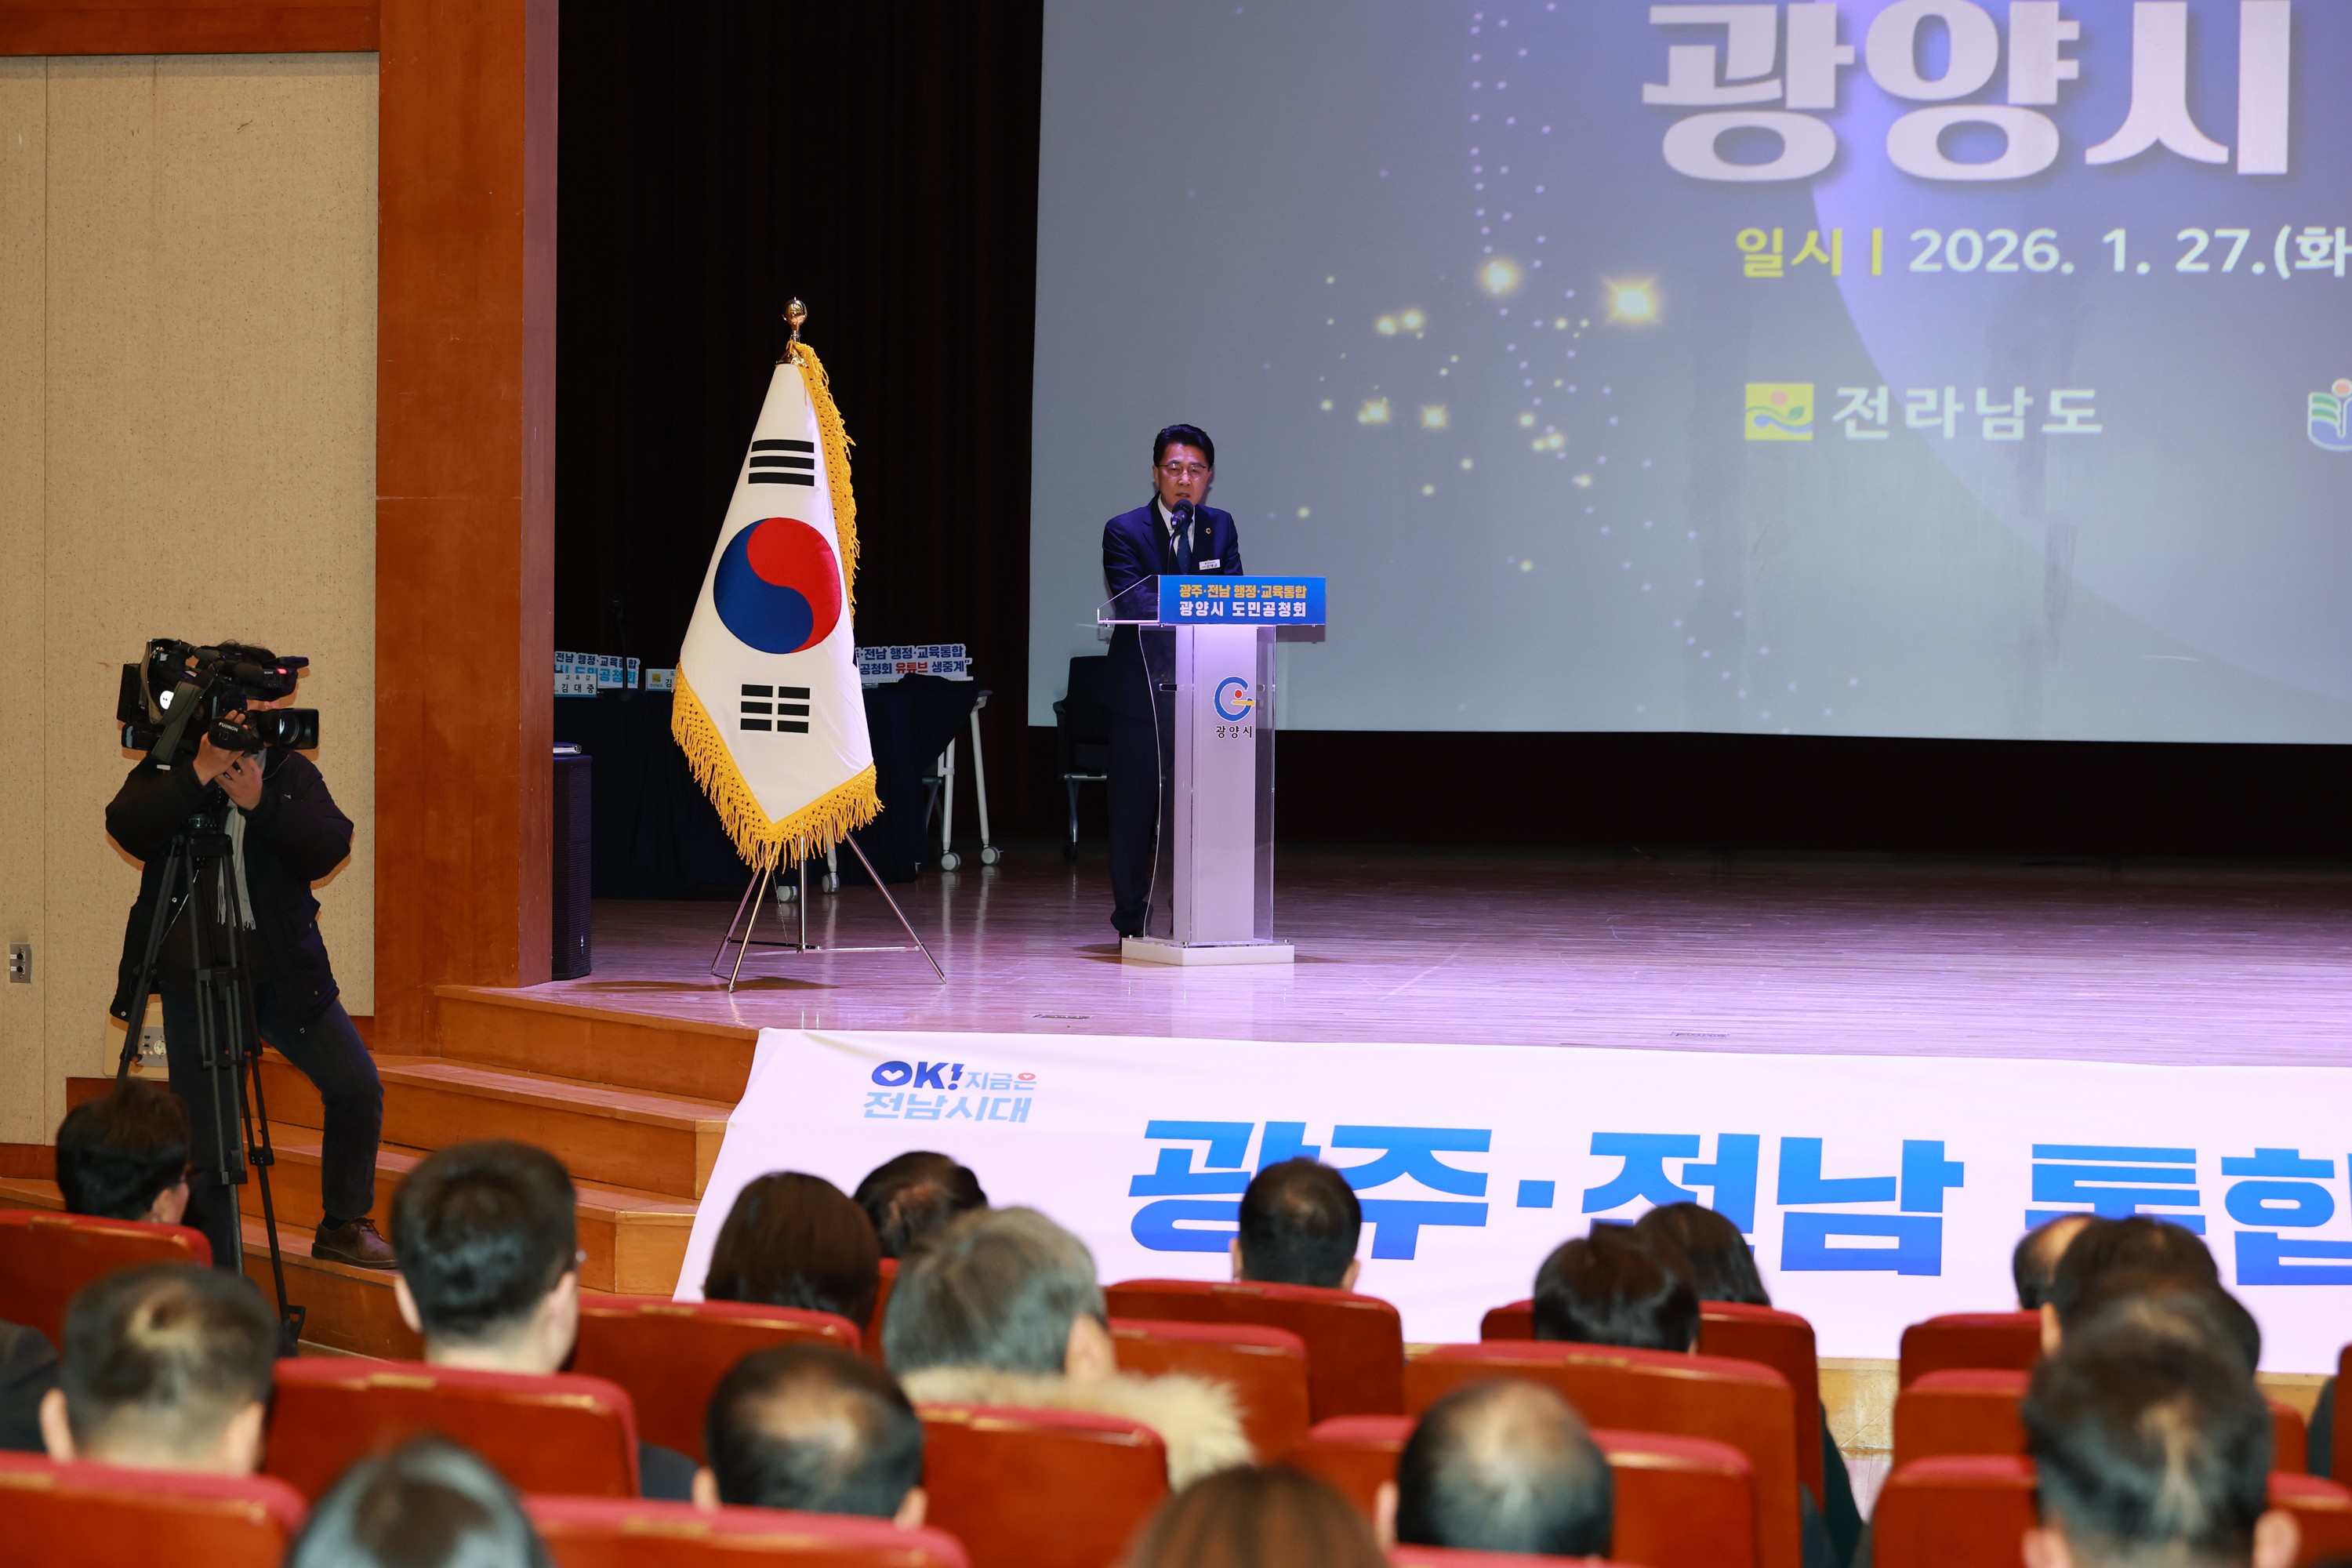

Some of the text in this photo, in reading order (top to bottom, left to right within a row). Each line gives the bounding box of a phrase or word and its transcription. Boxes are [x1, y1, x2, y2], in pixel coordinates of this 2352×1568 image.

[1642, 0, 2292, 181] 광양시
[1735, 227, 1842, 278] 일시
[1908, 227, 2076, 274] 2026.
[2102, 227, 2151, 274] 1.
[1831, 386, 2103, 441] 전라남도
[1179, 584, 1307, 599] 광주·전남 행정·교육통합
[1179, 601, 1306, 617] 광양시 도민공청회
[556, 652, 574, 663] 전남
[890, 645, 964, 660] 행정·교육통합
[860, 662, 892, 675] 공청회
[895, 662, 928, 674] 유튜브
[561, 683, 595, 694] 김대중
[218, 720, 239, 733] FUJINON
[1215, 725, 1253, 739] 광양시
[871, 1061, 1037, 1091] OK! 지금은
[863, 1092, 1033, 1123] 전남시대
